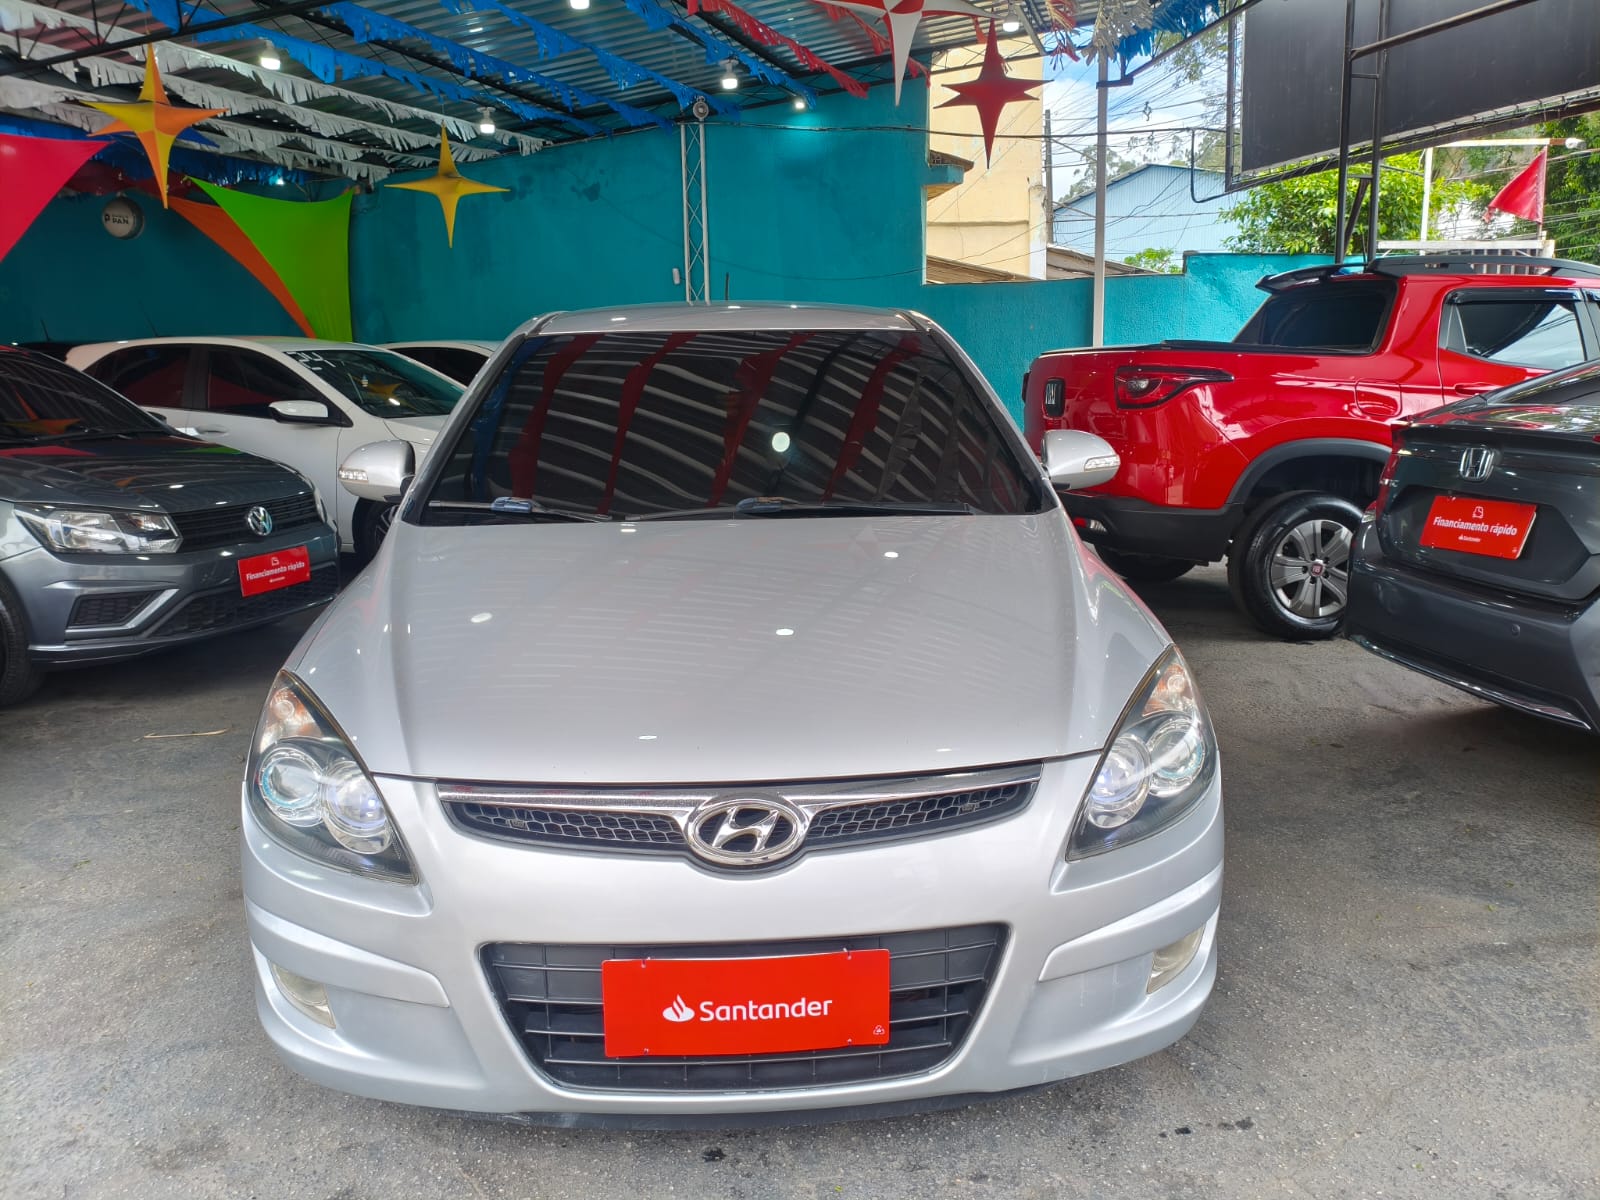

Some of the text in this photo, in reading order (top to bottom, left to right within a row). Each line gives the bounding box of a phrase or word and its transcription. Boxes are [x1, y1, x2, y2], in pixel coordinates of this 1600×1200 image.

[1433, 516, 1518, 537] Financiamento rápido
[246, 566, 287, 581] Financiamento
[699, 997, 833, 1022] Santander
